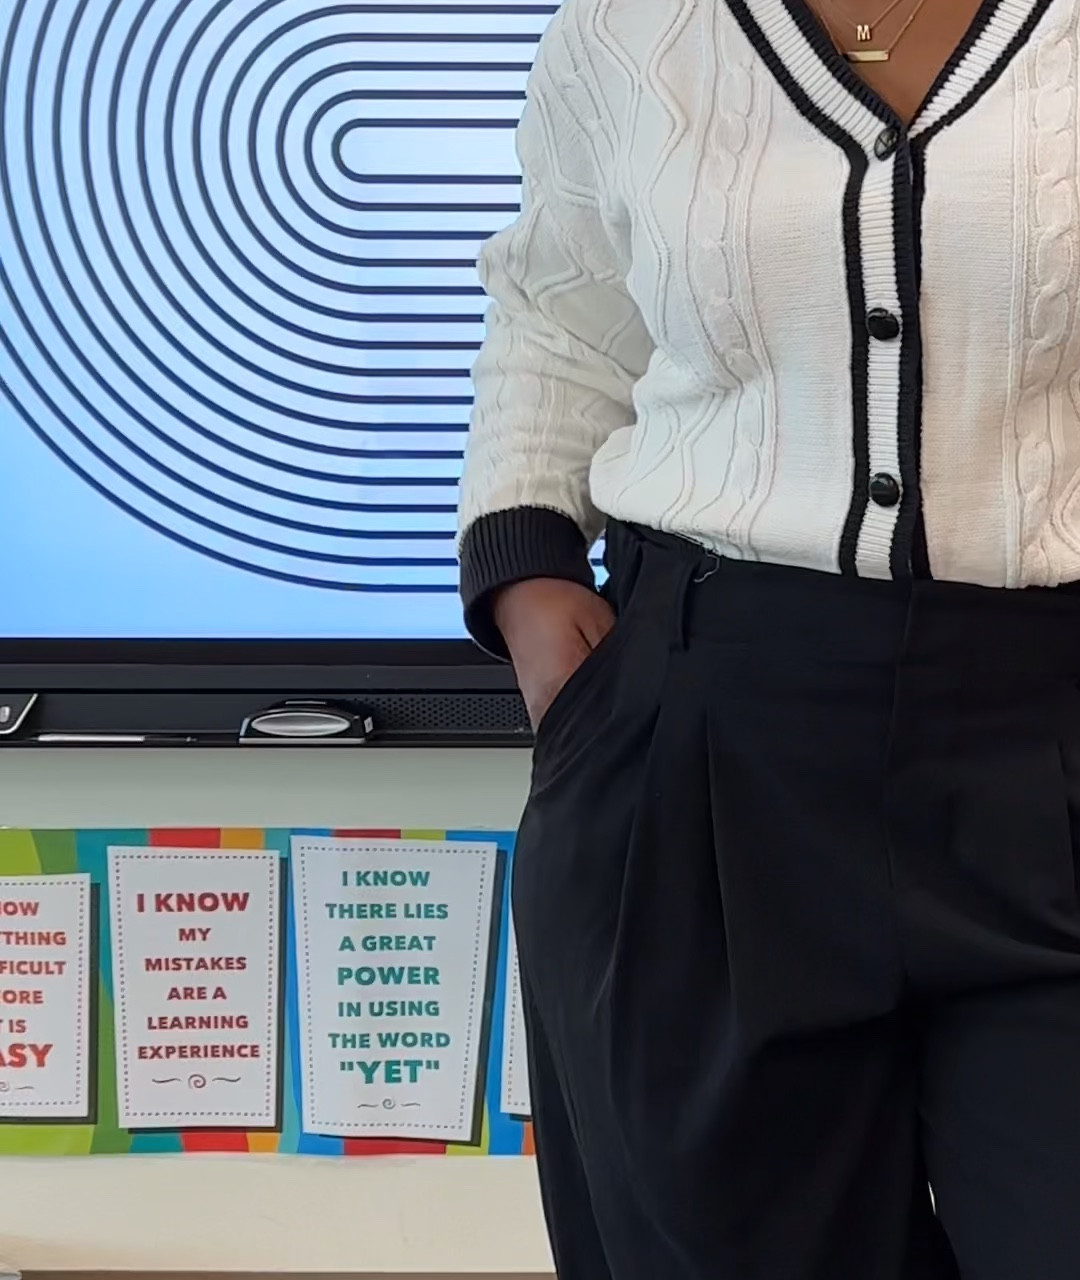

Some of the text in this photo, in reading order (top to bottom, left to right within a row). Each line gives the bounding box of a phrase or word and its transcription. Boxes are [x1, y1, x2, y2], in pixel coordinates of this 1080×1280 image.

[342, 871, 431, 888] I KNOW
[0, 901, 40, 916] OW
[136, 892, 250, 913] I KNOW
[325, 902, 449, 919] THERE LIES
[0, 931, 67, 946] THING
[178, 928, 212, 942] MY
[339, 935, 437, 952] A GREAT
[145, 956, 248, 972] MISTAKES
[337, 966, 441, 986] POWER
[0, 990, 44, 1005] ORE
[167, 986, 227, 1001] ARE A
[338, 1000, 441, 1018] IN USING
[146, 1015, 249, 1031] LEARNING
[328, 1032, 452, 1049] THE WORD
[137, 1043, 261, 1060] EXPERIENCE
[339, 1059, 442, 1085] "YET"
